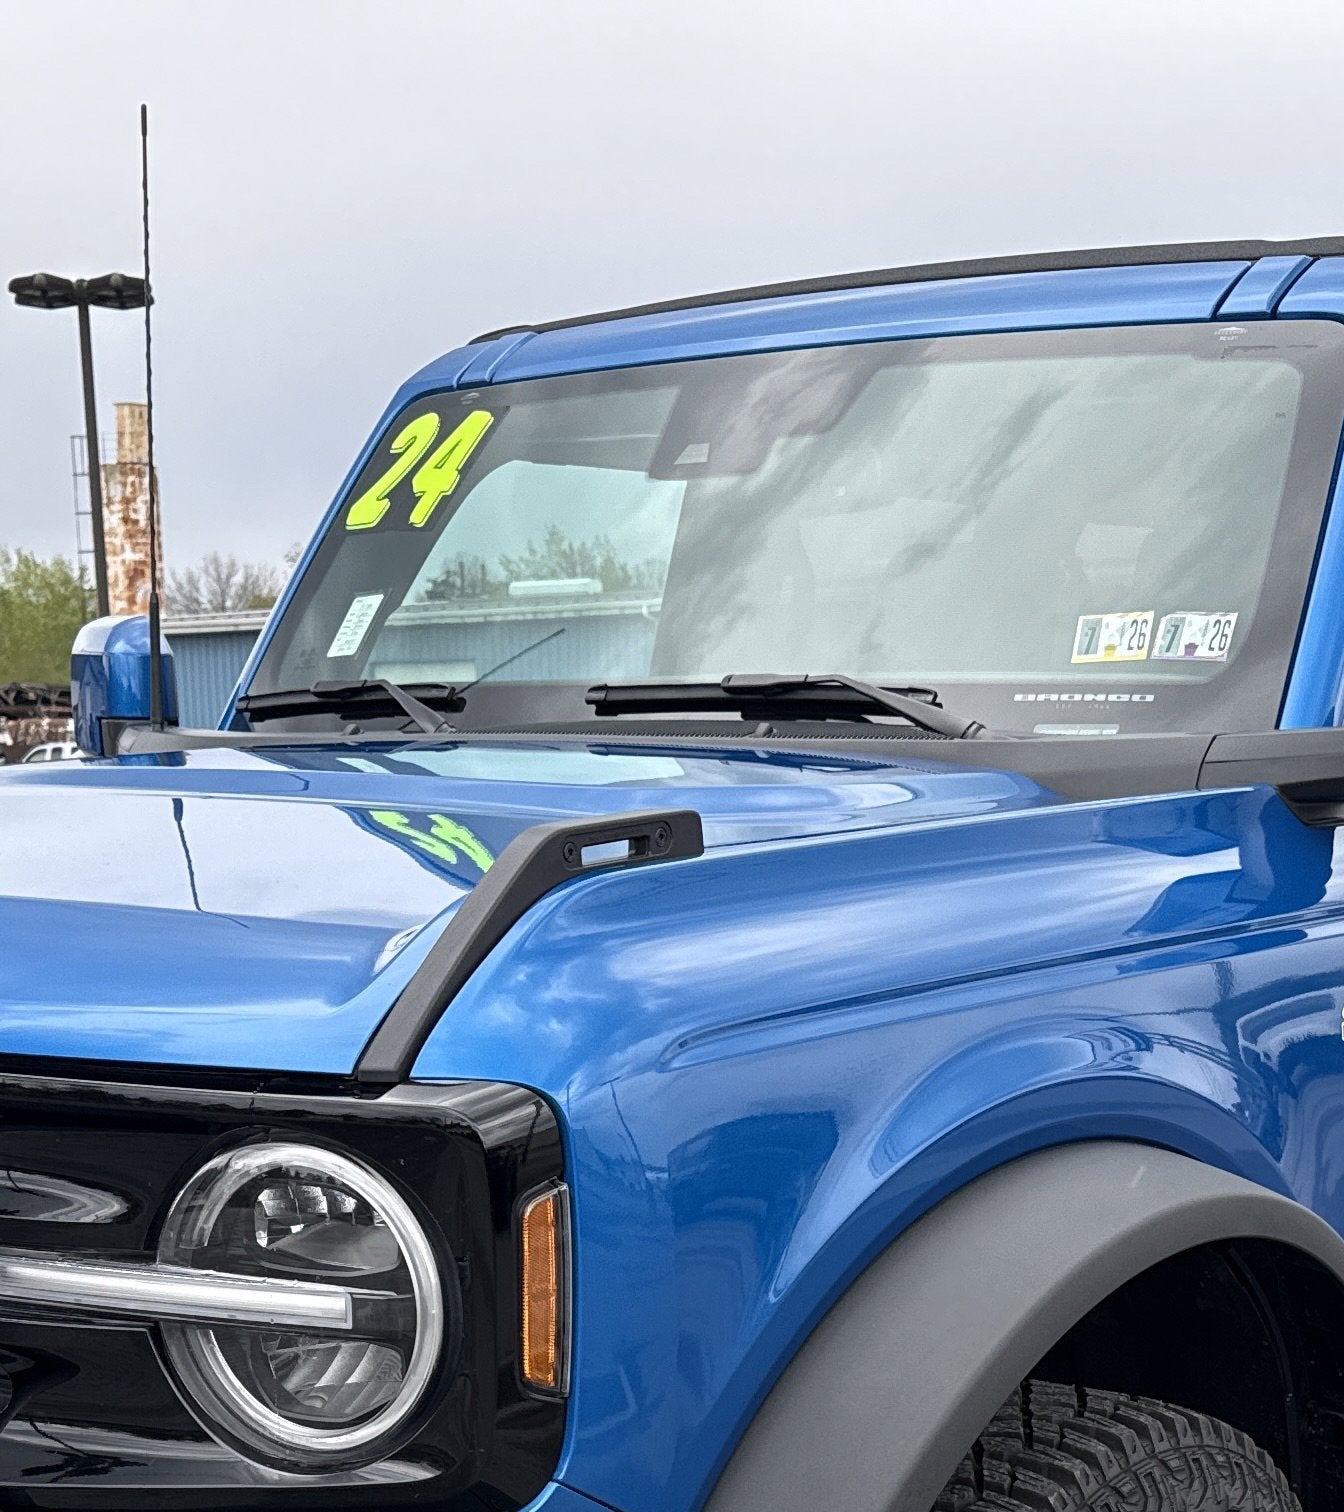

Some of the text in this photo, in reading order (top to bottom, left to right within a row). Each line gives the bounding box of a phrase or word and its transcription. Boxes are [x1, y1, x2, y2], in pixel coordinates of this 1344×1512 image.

[346, 409, 495, 531] 24
[1127, 618, 1149, 651] 26
[1164, 618, 1232, 653] 7 26
[1013, 693, 1155, 702] BRONCO
